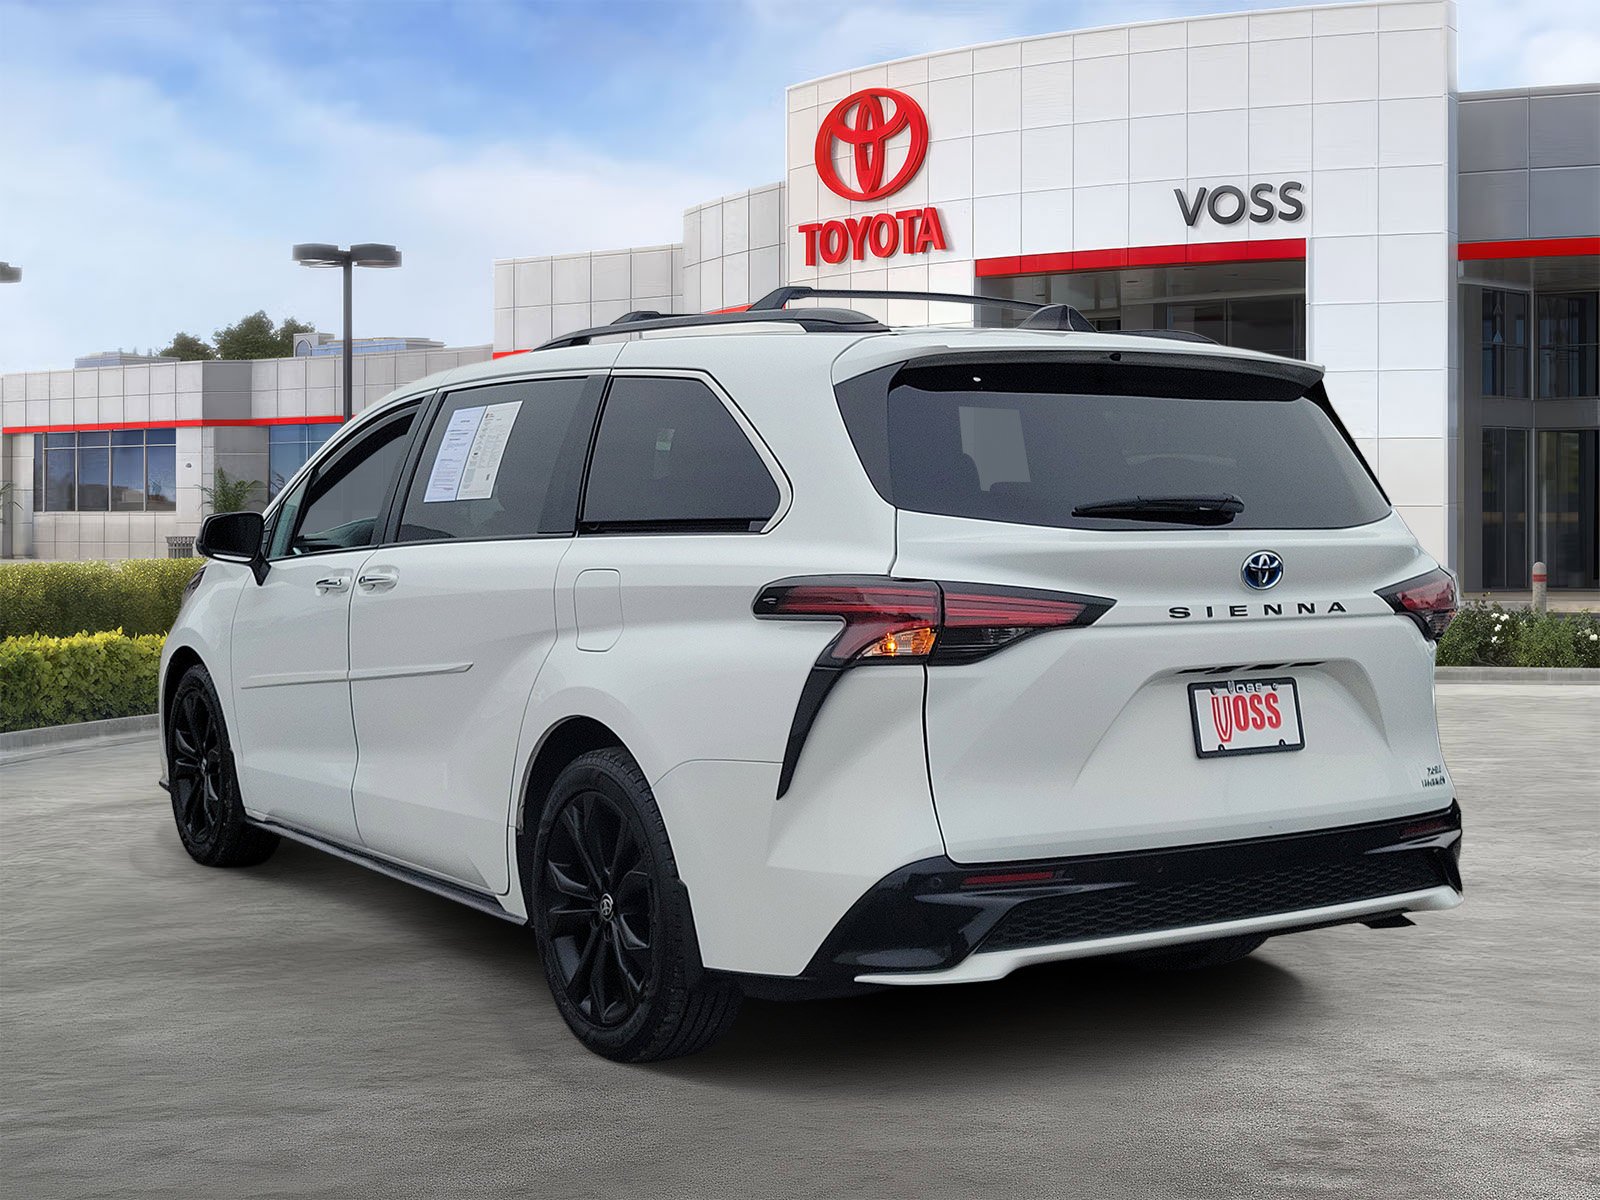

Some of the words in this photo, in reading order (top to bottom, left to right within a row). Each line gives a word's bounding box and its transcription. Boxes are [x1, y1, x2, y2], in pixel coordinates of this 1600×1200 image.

[1174, 181, 1306, 227] VOSS
[798, 206, 949, 267] TOYOTA
[1168, 601, 1347, 619] SIENNA
[1211, 692, 1282, 743] VOSS
